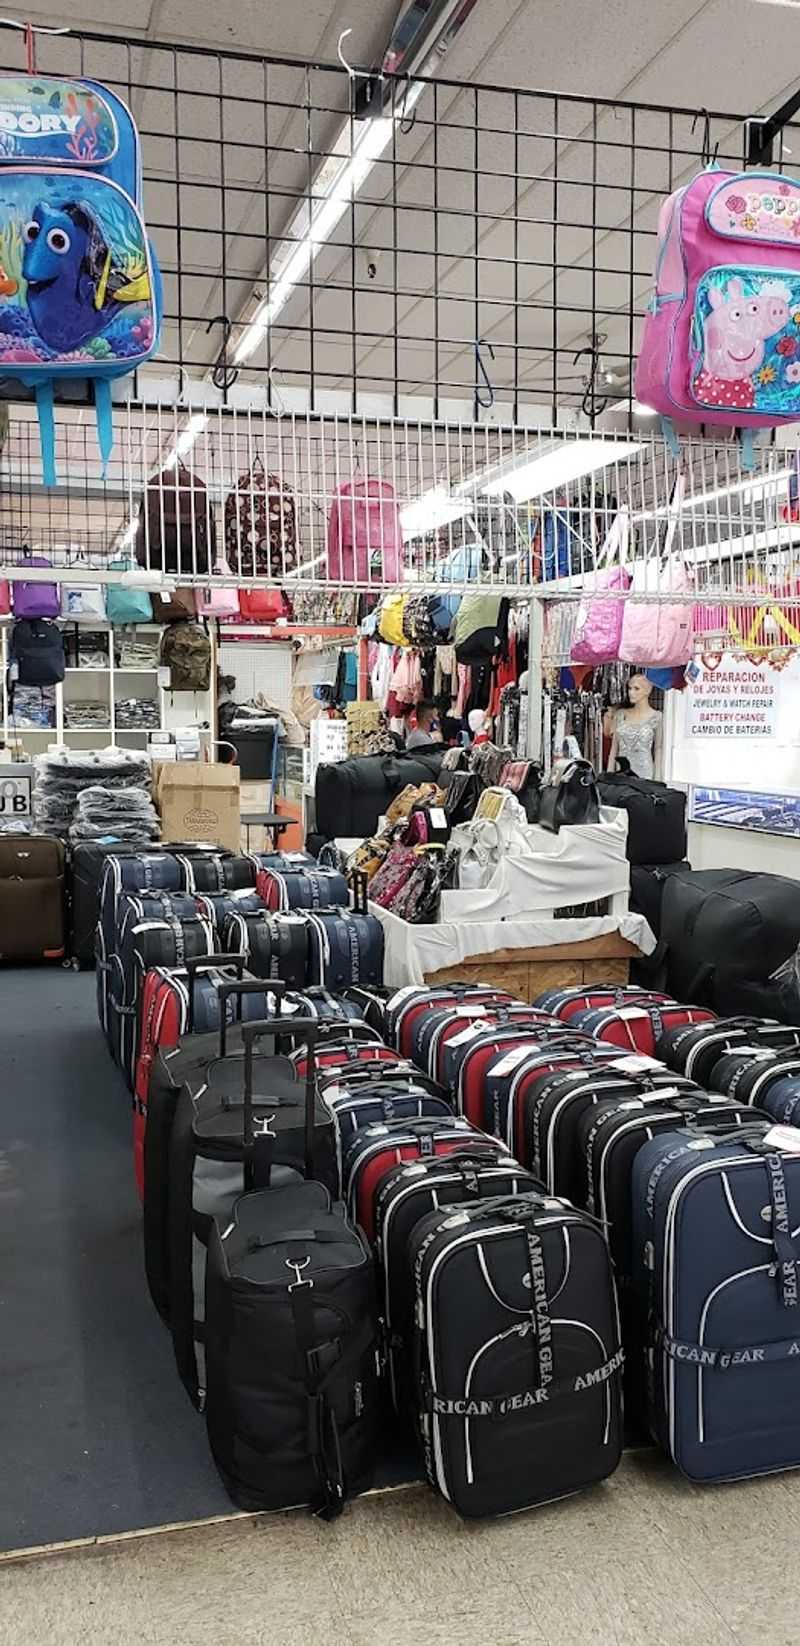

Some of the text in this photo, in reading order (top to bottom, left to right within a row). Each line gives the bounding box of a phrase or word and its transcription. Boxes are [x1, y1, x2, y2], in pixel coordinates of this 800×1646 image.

[0, 112, 81, 133] DORY
[702, 672, 765, 682] REPARACION
[693, 685, 774, 694] DE JOYAS Y RELOJES
[729, 699, 750, 708] WATCH
[700, 713, 766, 722] BATTERY CHANGE
[692, 725, 772, 734] CAMBIO DE BATERIAS
[528, 1233, 552, 1344] AMERICAN
